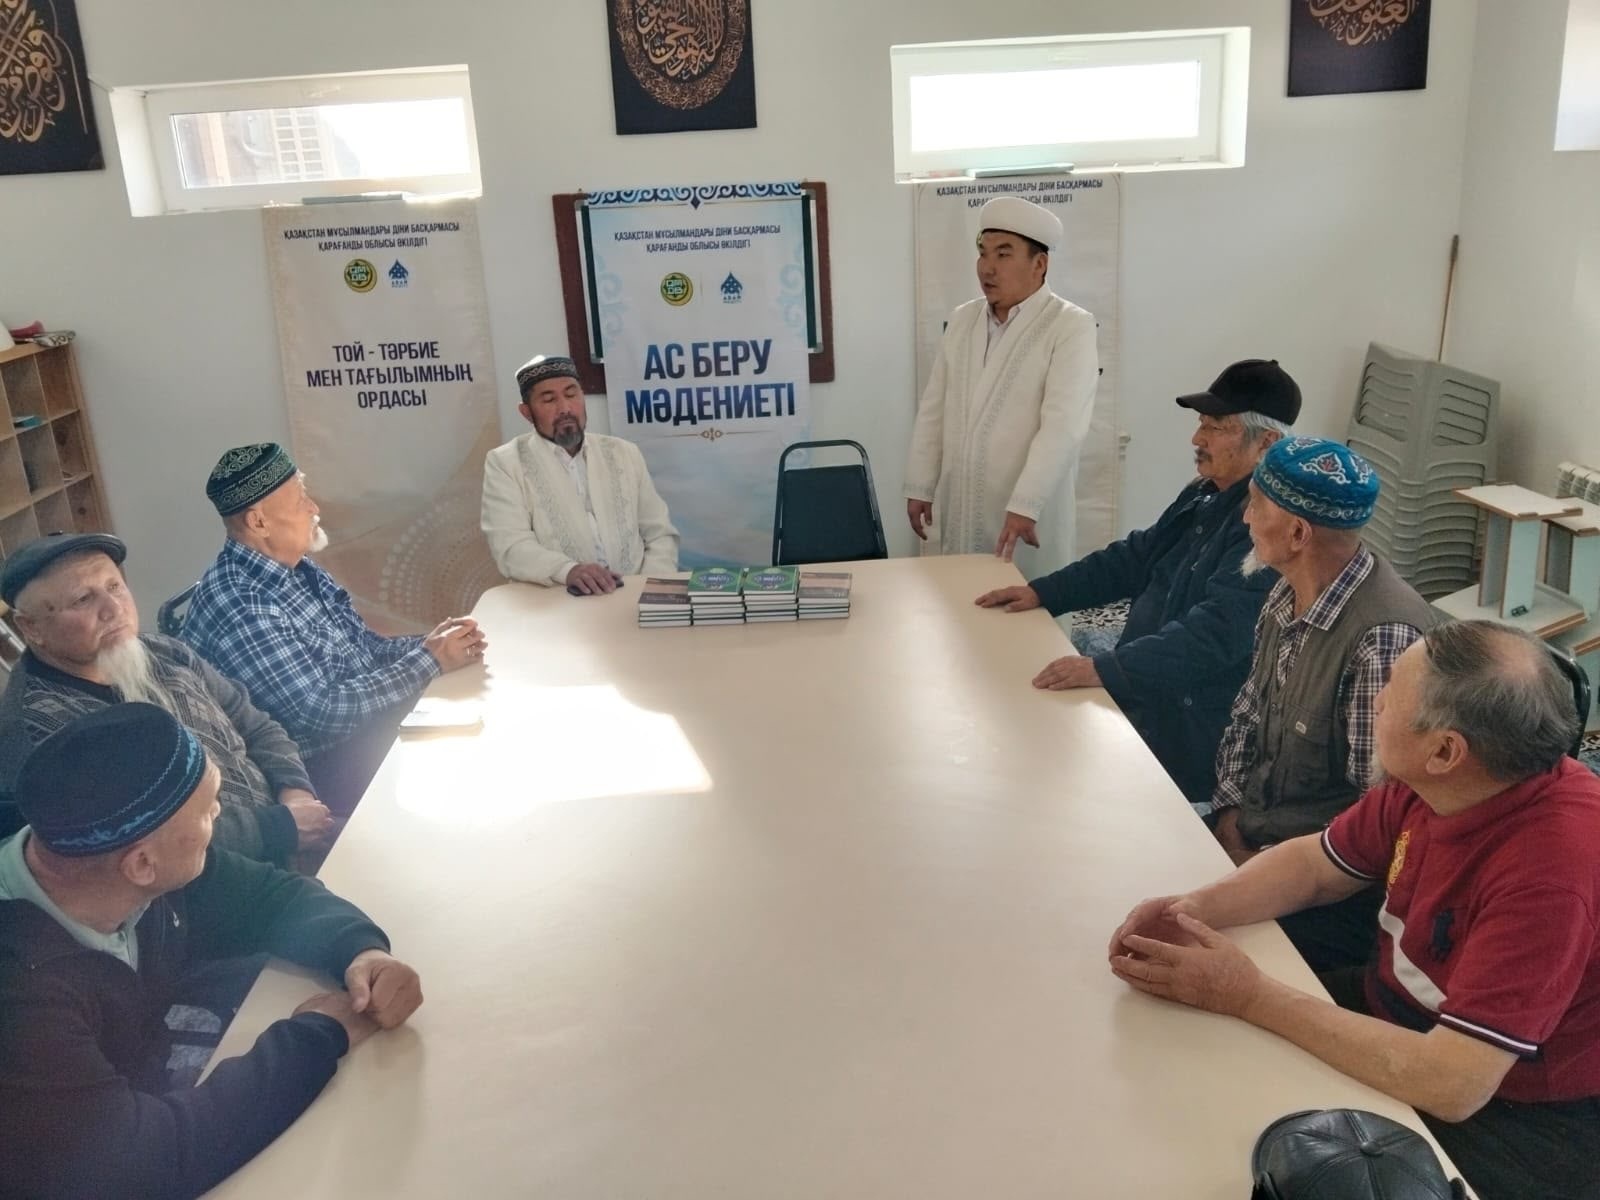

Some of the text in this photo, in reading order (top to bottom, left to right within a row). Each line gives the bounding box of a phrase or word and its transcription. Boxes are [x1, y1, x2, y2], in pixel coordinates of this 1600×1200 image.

[937, 184, 976, 196] ҚАЗАҚСТАН
[1056, 179, 1103, 191] БАСҚАРМАСЫ
[284, 227, 325, 240] ҚАЗАҚСТАН
[411, 222, 459, 235] БАСҚАРМАСЫ
[614, 231, 653, 242] ҚАЗАҚСТАН
[733, 225, 780, 237] БАСҚАРМАСЫ
[318, 240, 363, 251] ҚАРАҒАНДЫ
[364, 239, 395, 250] ОБЛЫСЫ
[646, 242, 688, 253] ҚАРАҒАНДЫ
[332, 341, 365, 363] ТОЙ
[378, 341, 440, 361] ТӘРБИЕ
[643, 339, 772, 380] АС БЕРУ
[306, 364, 473, 387] МЕН ТАҒЫЛЫМНЫҢ
[357, 389, 427, 410] ОРДАСЫ
[625, 382, 795, 426] МӘДЕНИЕТІ
